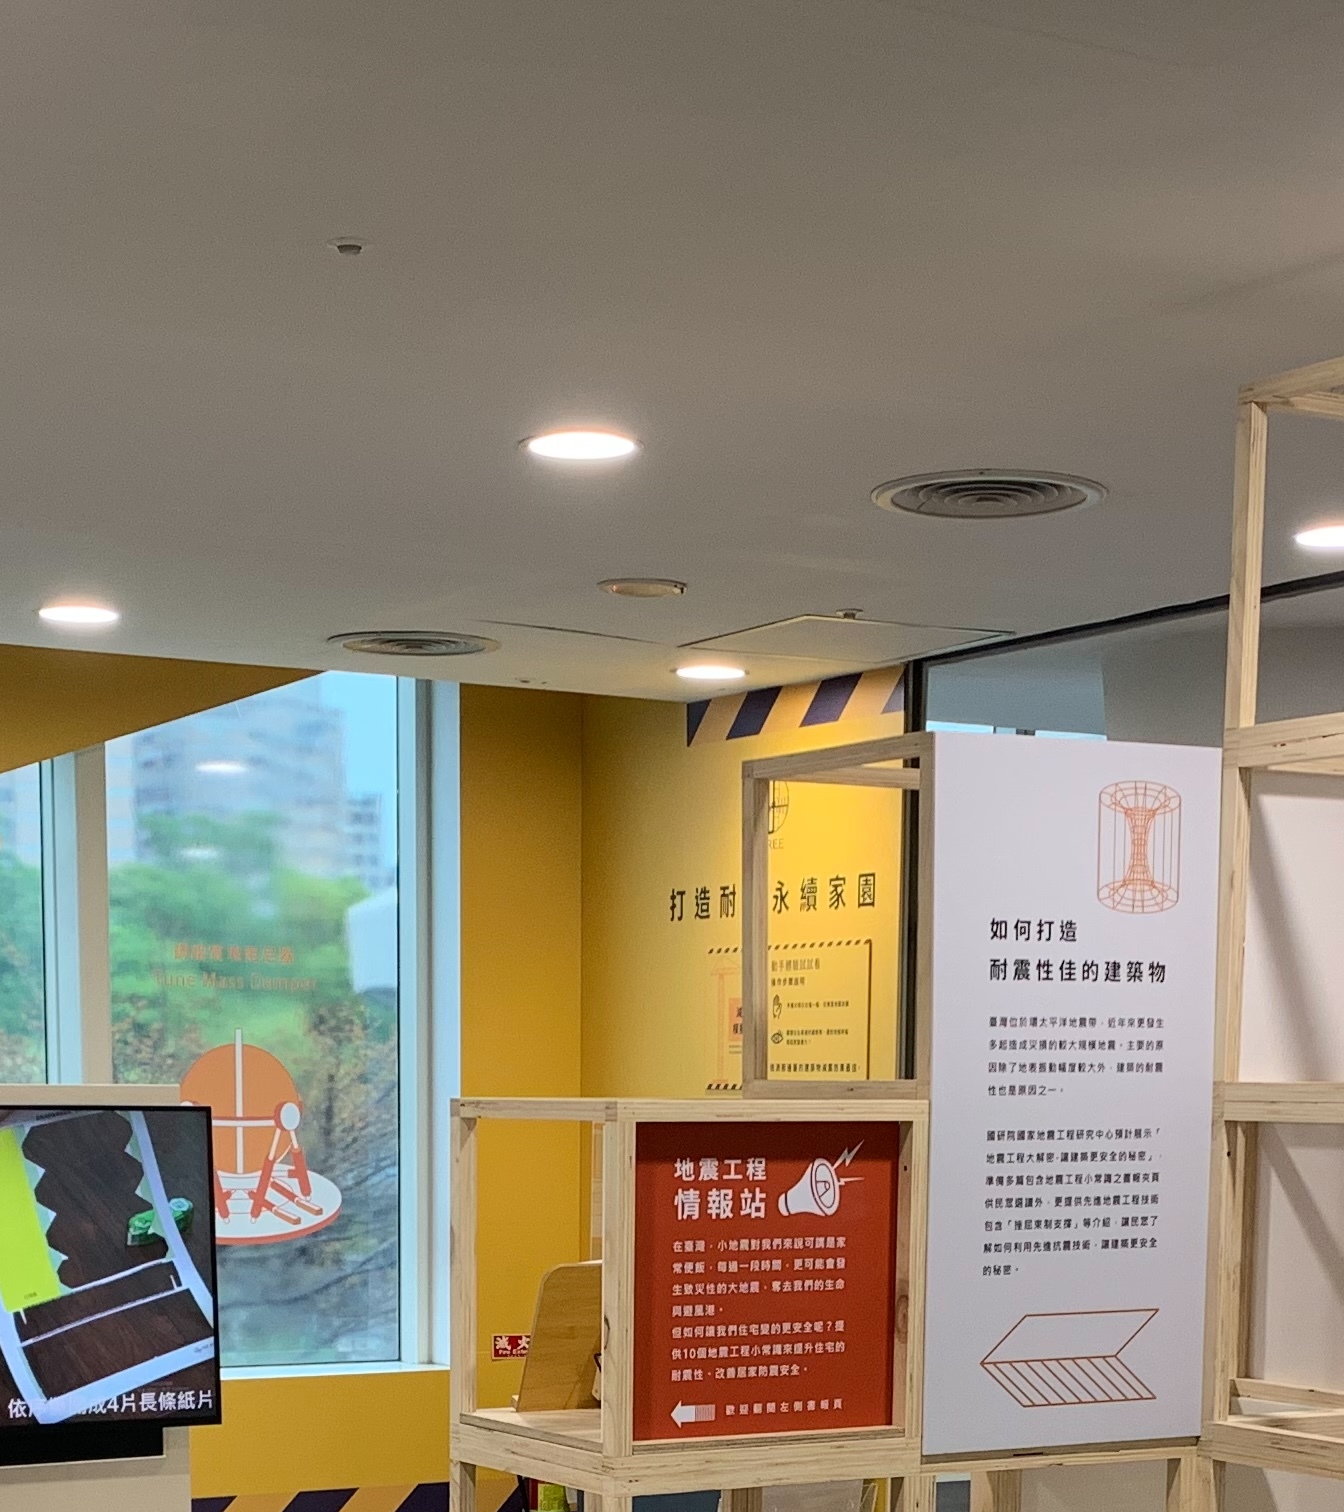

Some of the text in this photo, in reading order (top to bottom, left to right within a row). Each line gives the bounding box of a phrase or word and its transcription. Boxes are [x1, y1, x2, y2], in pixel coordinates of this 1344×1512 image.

[669, 872, 877, 922] 打造耐永續家園
[989, 917, 1079, 942] 如何打造
[988, 958, 1167, 984] 耐震性佳的建築物
[674, 1157, 767, 1182] 地震工程
[673, 1187, 767, 1221] 情報站
